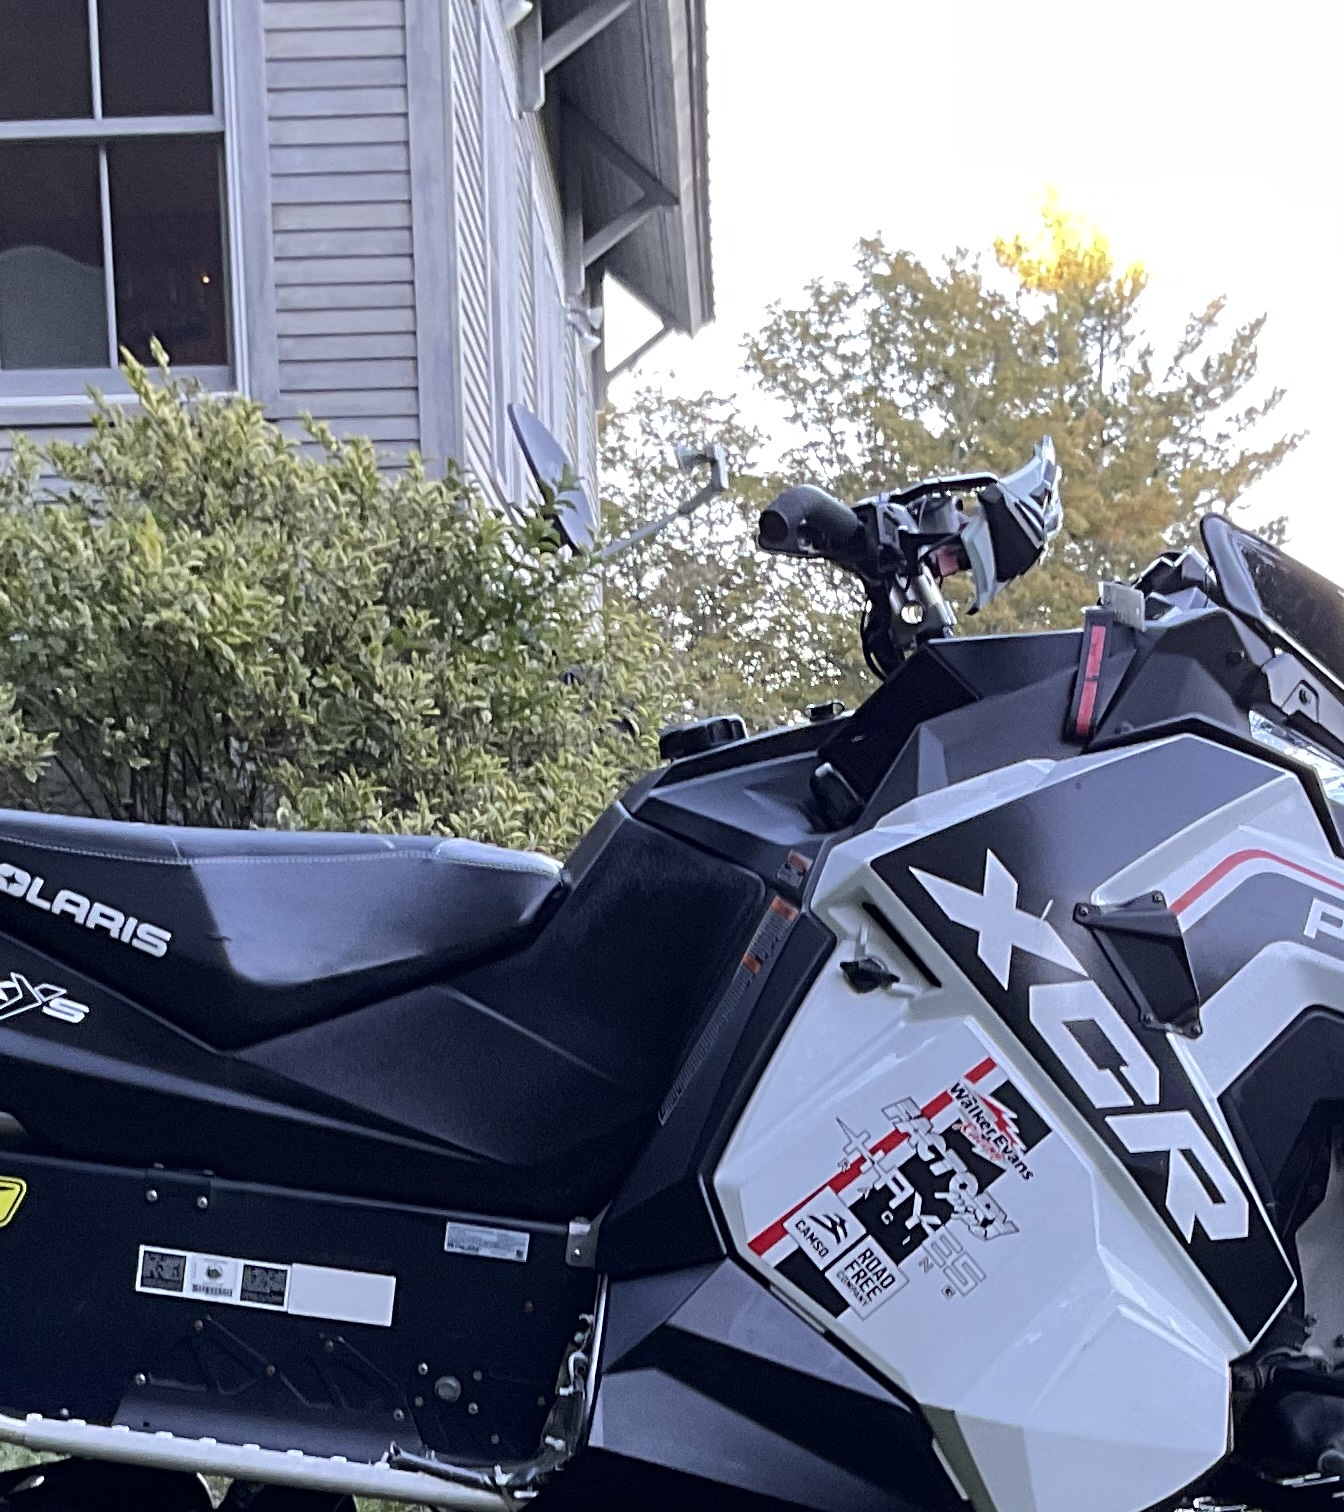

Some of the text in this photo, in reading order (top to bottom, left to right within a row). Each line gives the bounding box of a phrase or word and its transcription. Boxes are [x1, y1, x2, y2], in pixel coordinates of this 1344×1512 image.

[909, 848, 1250, 1242] XCR
[881, 1097, 1019, 1241] FACTORY
[951, 1082, 1034, 1180] Walker Evans
[795, 1219, 830, 1259] CAMSO
[836, 1116, 987, 1297] HAYES
[844, 1260, 883, 1302] FREE
[858, 1247, 896, 1289] ROAD
